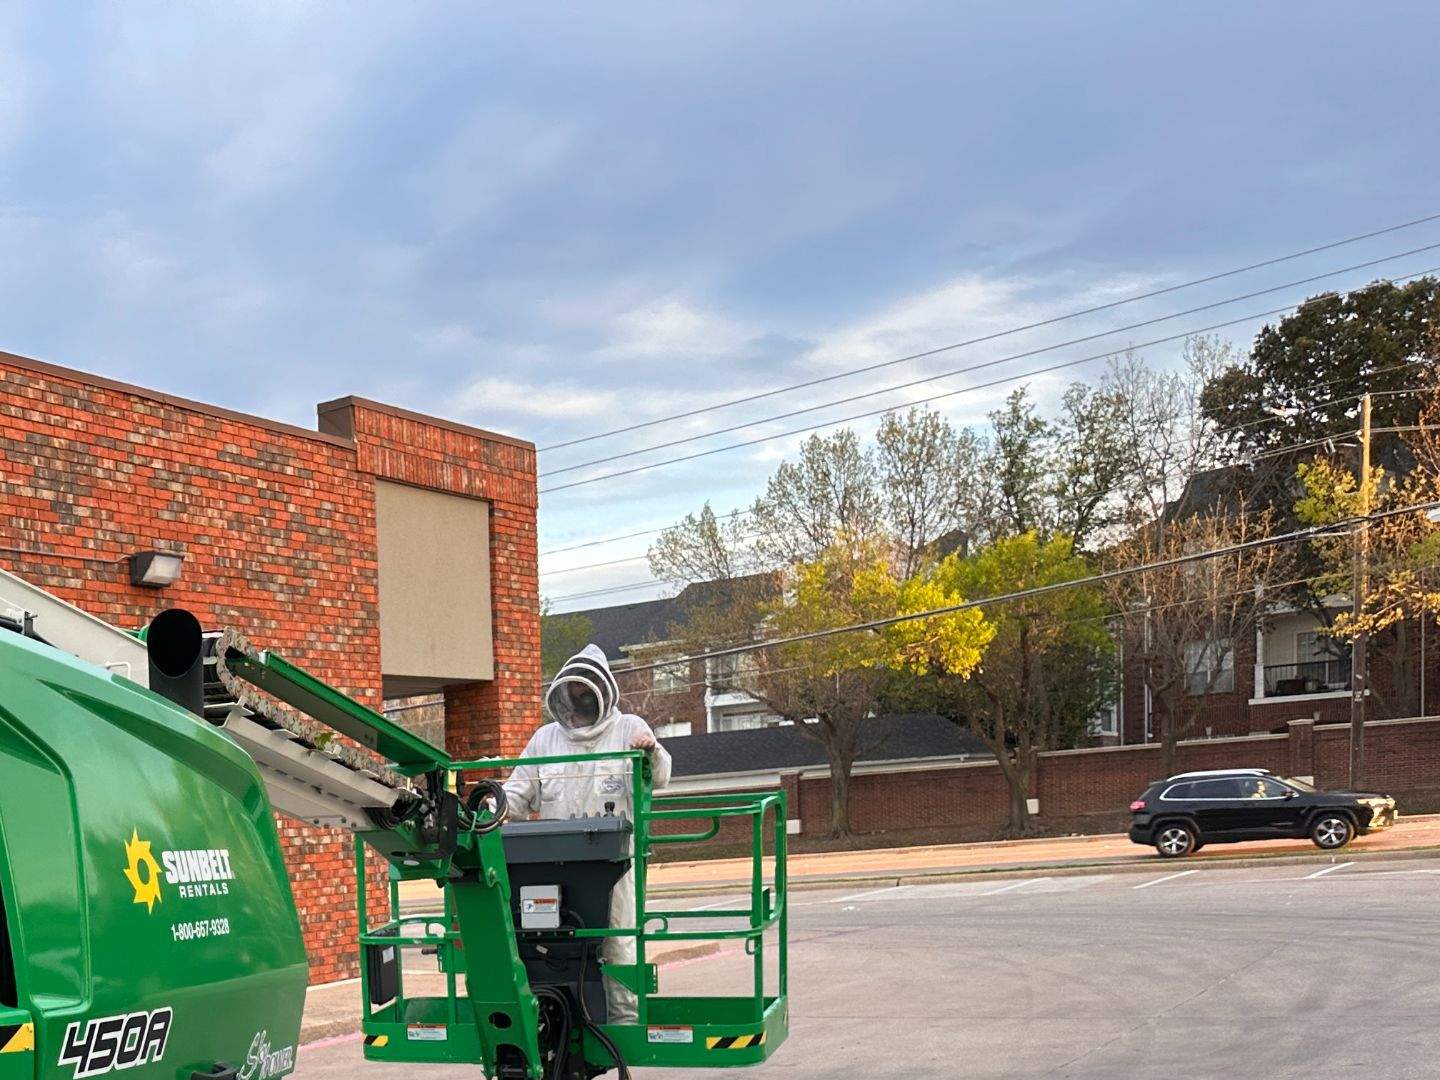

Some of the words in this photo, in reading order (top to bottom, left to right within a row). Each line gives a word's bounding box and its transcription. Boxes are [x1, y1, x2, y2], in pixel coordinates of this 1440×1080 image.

[161, 849, 233, 884] SUNBELT
[179, 882, 229, 898] RENTALS
[58, 1007, 173, 1080] 450A
